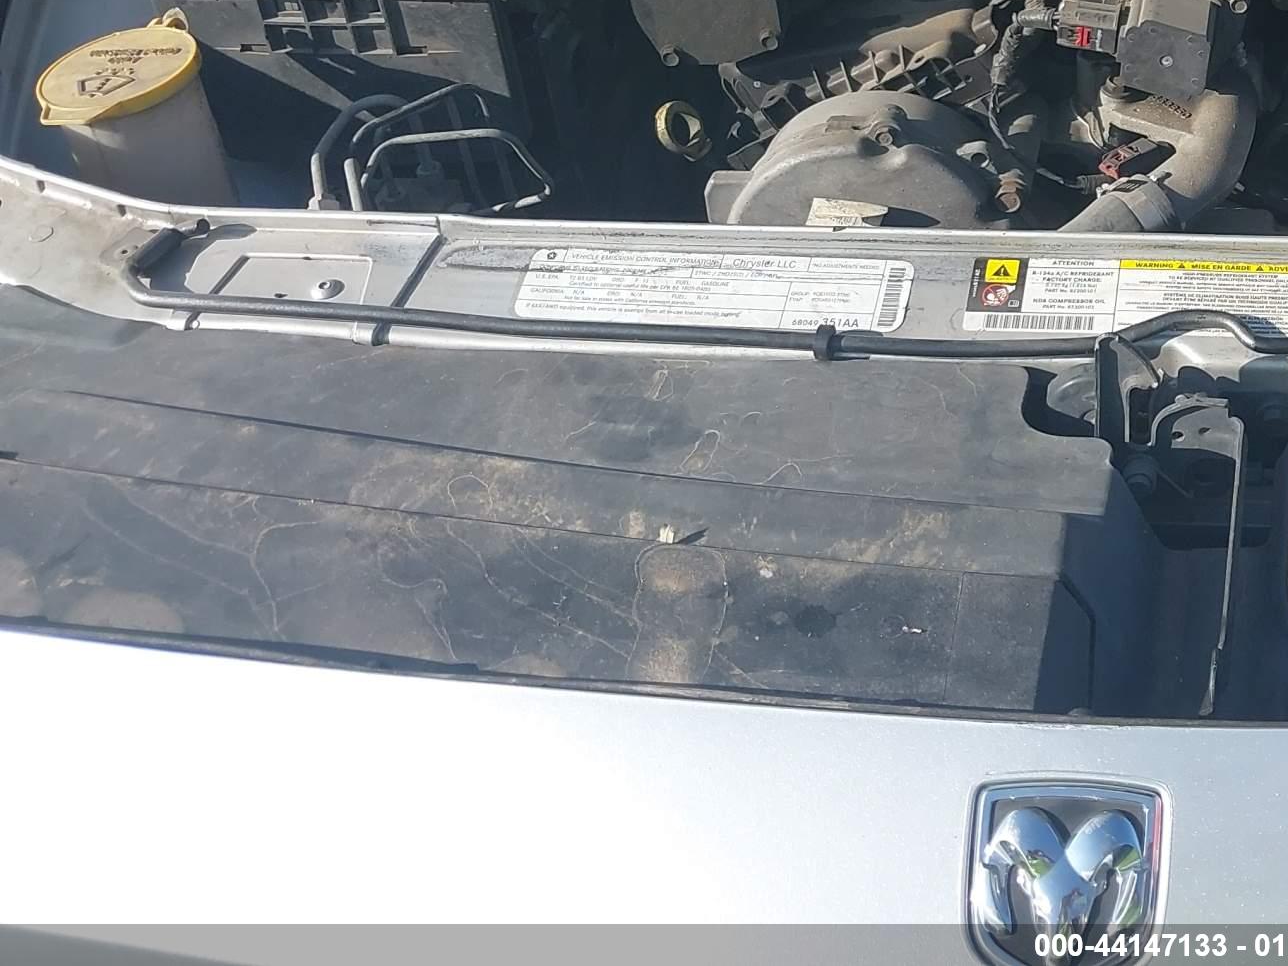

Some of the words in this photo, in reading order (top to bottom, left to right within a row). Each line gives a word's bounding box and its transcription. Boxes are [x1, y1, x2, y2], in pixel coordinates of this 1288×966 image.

[571, 253, 599, 261] VEHICLE
[601, 254, 635, 262] EMISSION
[636, 255, 668, 263] CONTROL
[732, 258, 775, 269] Chrysler
[777, 260, 796, 269] LLC
